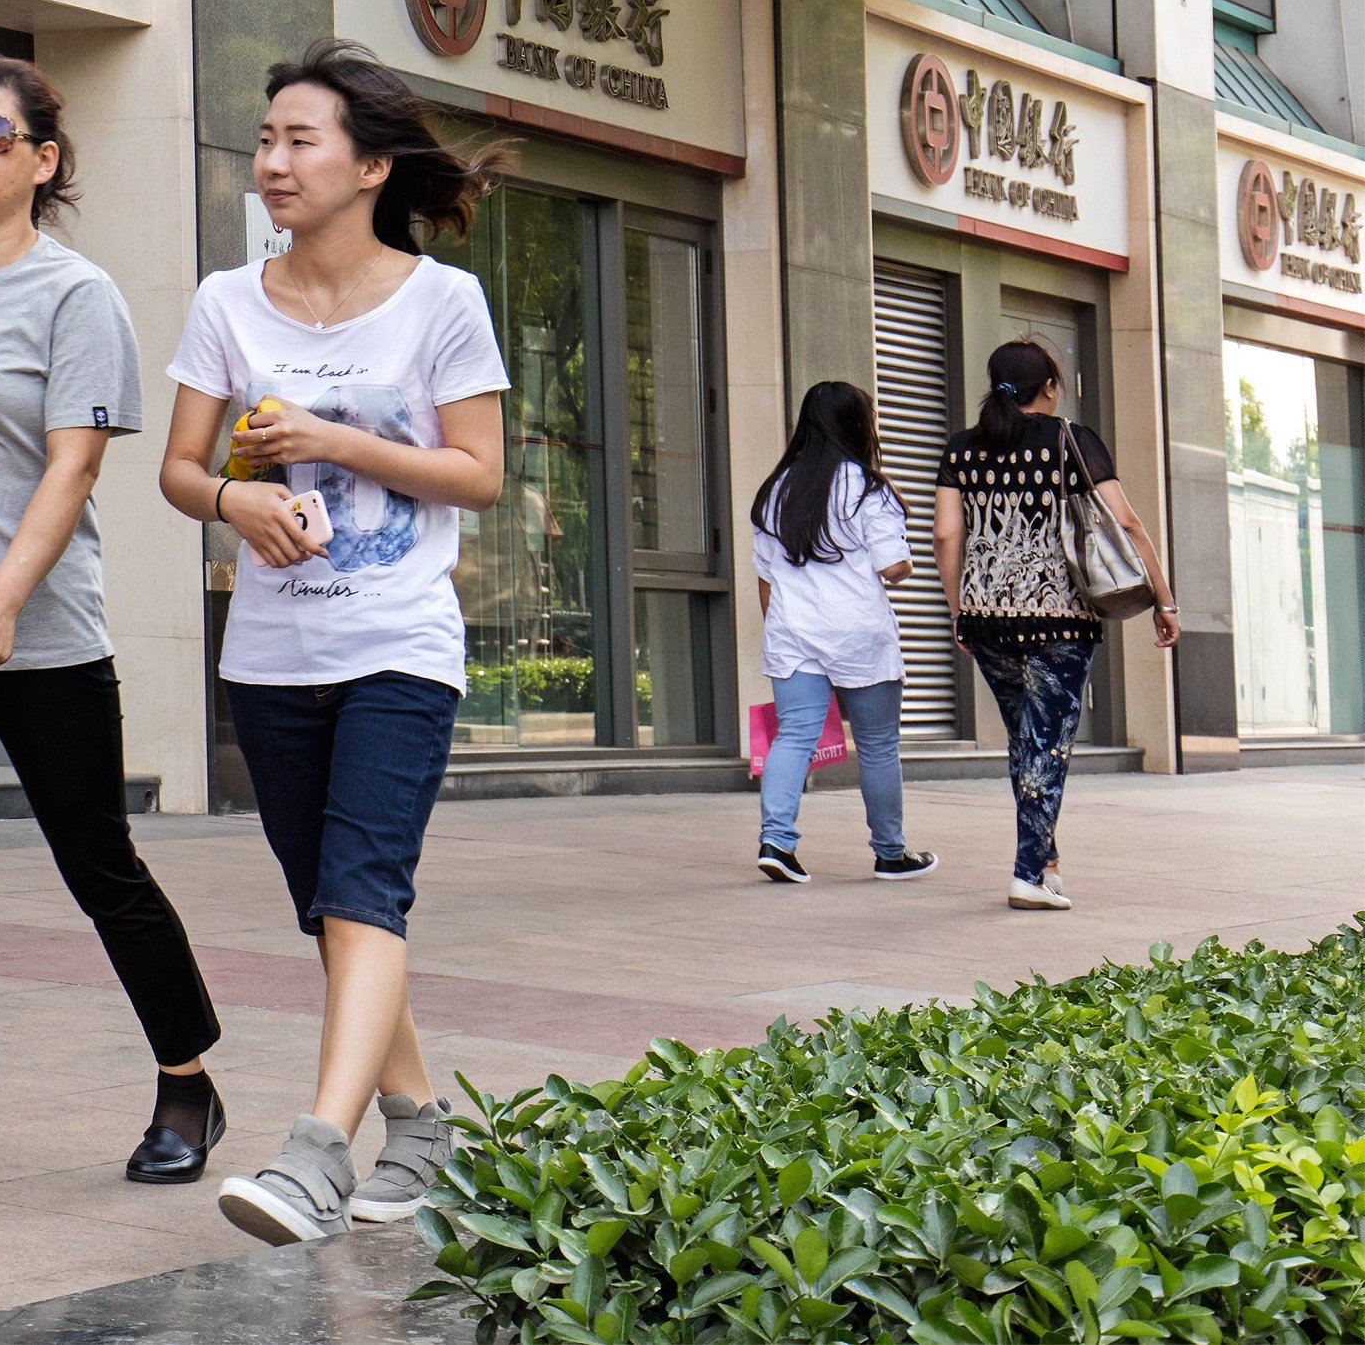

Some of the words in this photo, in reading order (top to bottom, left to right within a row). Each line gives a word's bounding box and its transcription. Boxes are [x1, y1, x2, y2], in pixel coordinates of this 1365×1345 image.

[496, 33, 560, 80] BANK
[564, 55, 596, 89] OF
[600, 64, 670, 109] CHINA
[273, 364, 290, 373] I
[316, 364, 352, 378] back
